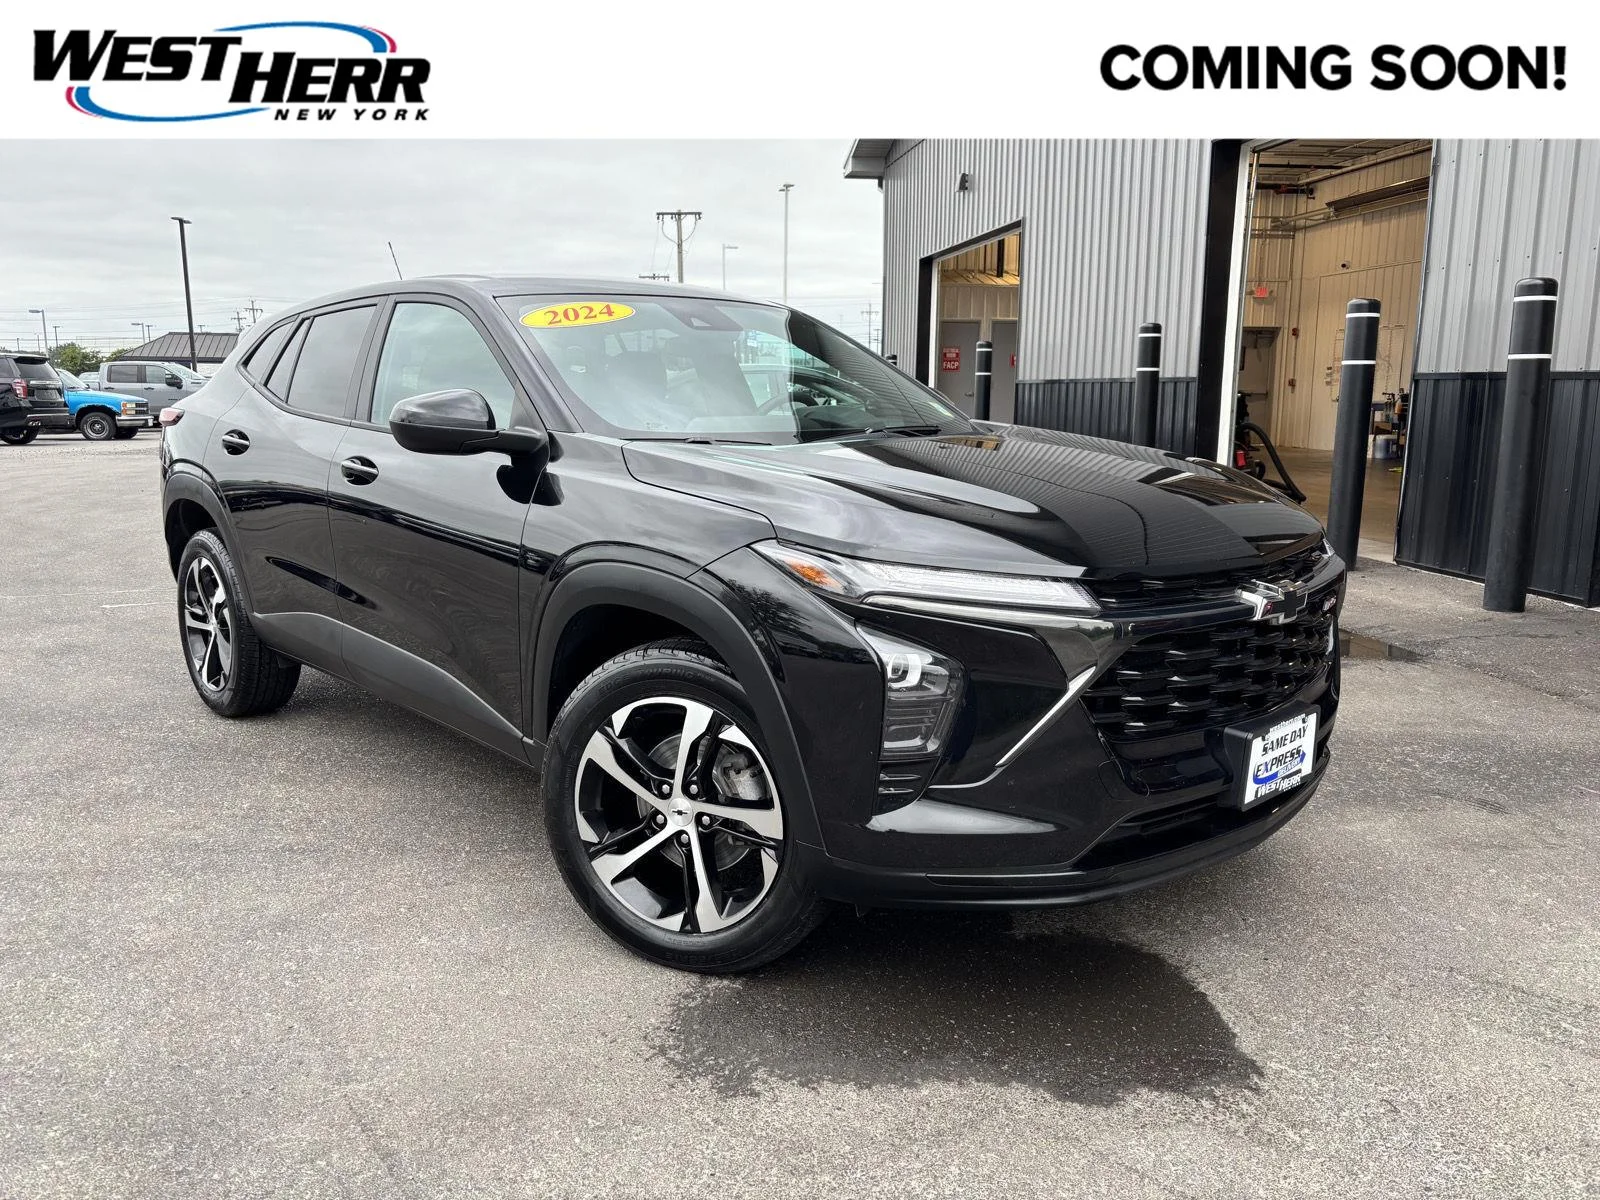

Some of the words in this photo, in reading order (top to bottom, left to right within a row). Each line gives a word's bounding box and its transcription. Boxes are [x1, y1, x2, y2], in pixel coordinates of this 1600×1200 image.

[543, 303, 615, 326] 2024
[943, 361, 960, 369] FACP
[1261, 733, 1289, 757] SAME
[1290, 724, 1309, 745] DAY
[1256, 745, 1303, 778] EXPRESS
